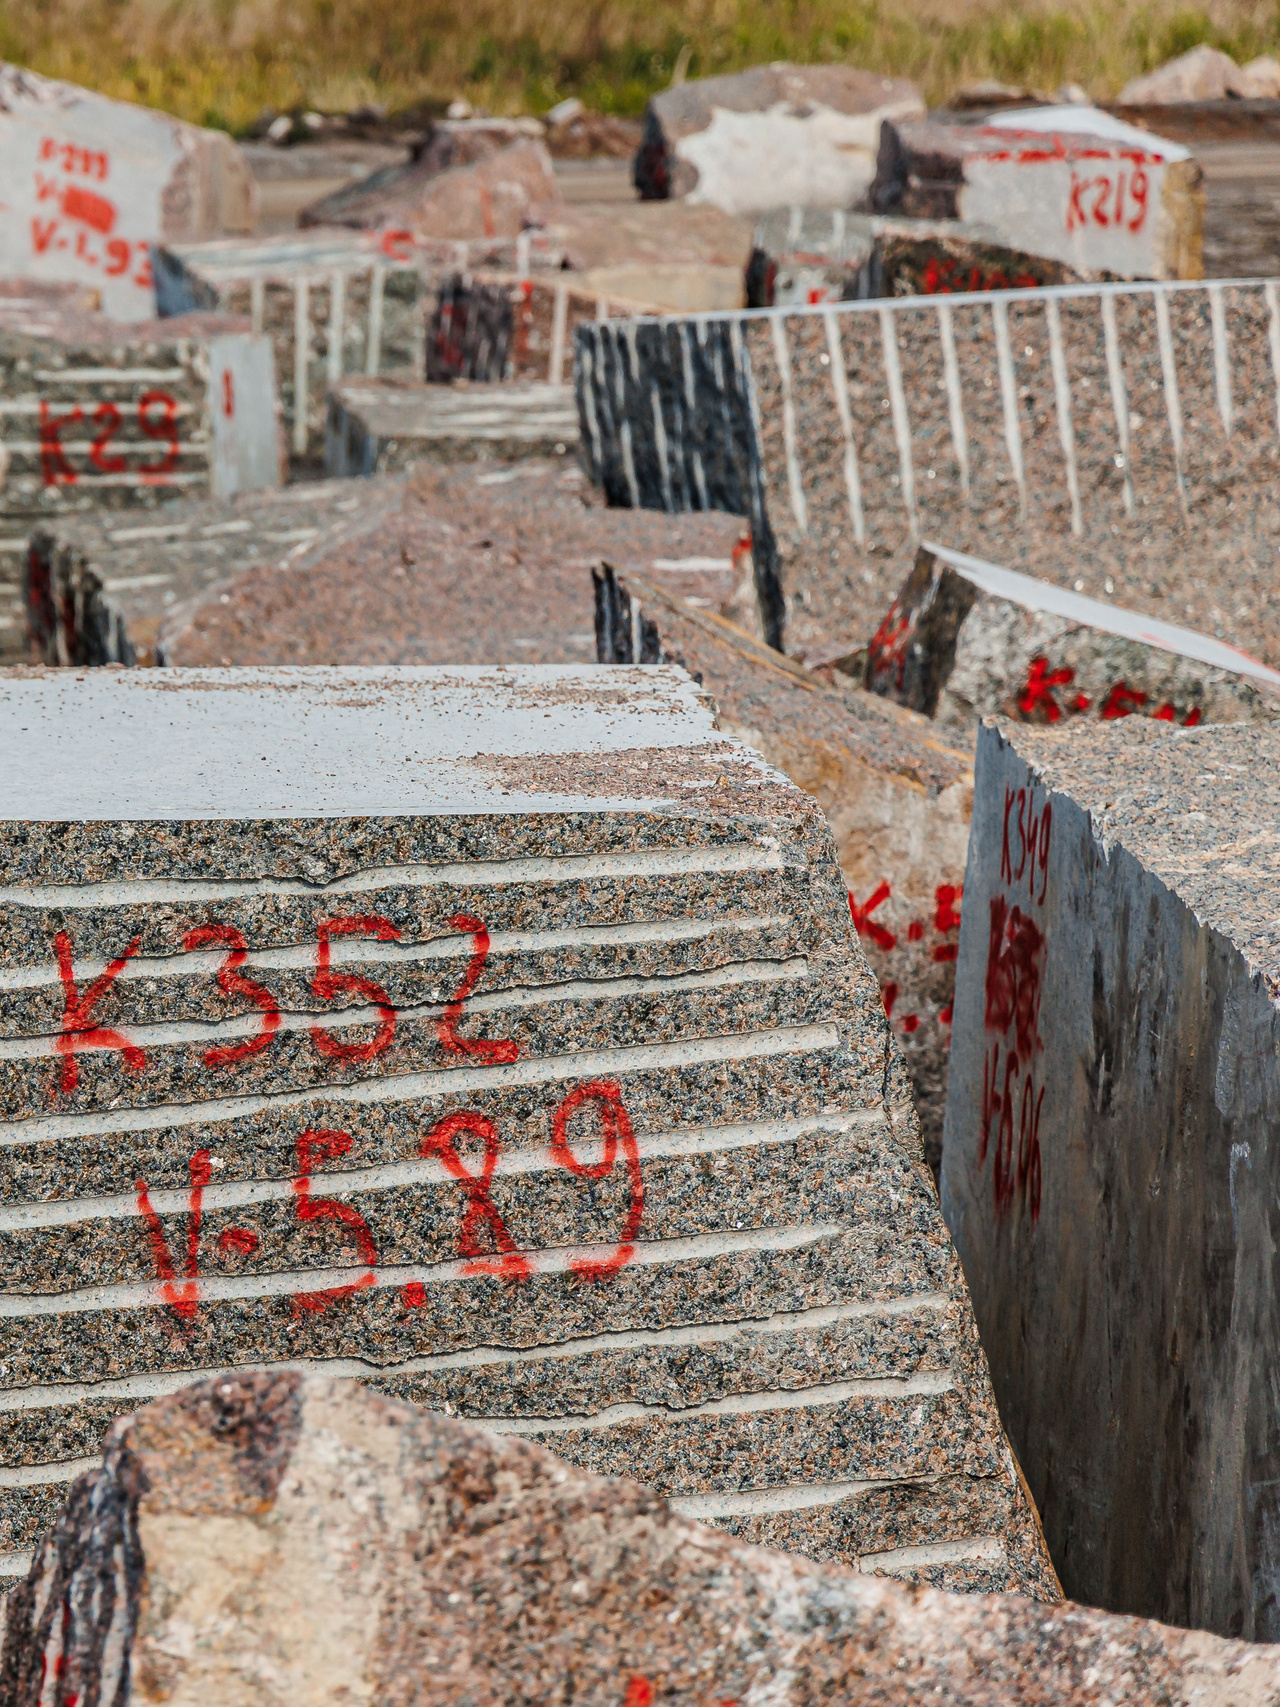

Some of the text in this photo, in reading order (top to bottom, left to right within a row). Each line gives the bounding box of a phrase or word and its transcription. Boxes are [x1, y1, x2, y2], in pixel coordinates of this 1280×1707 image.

[1067, 170, 1147, 234] K219
[39, 391, 179, 486] K29
[1000, 783, 1052, 907] K349
[53, 914, 520, 1094] K352
